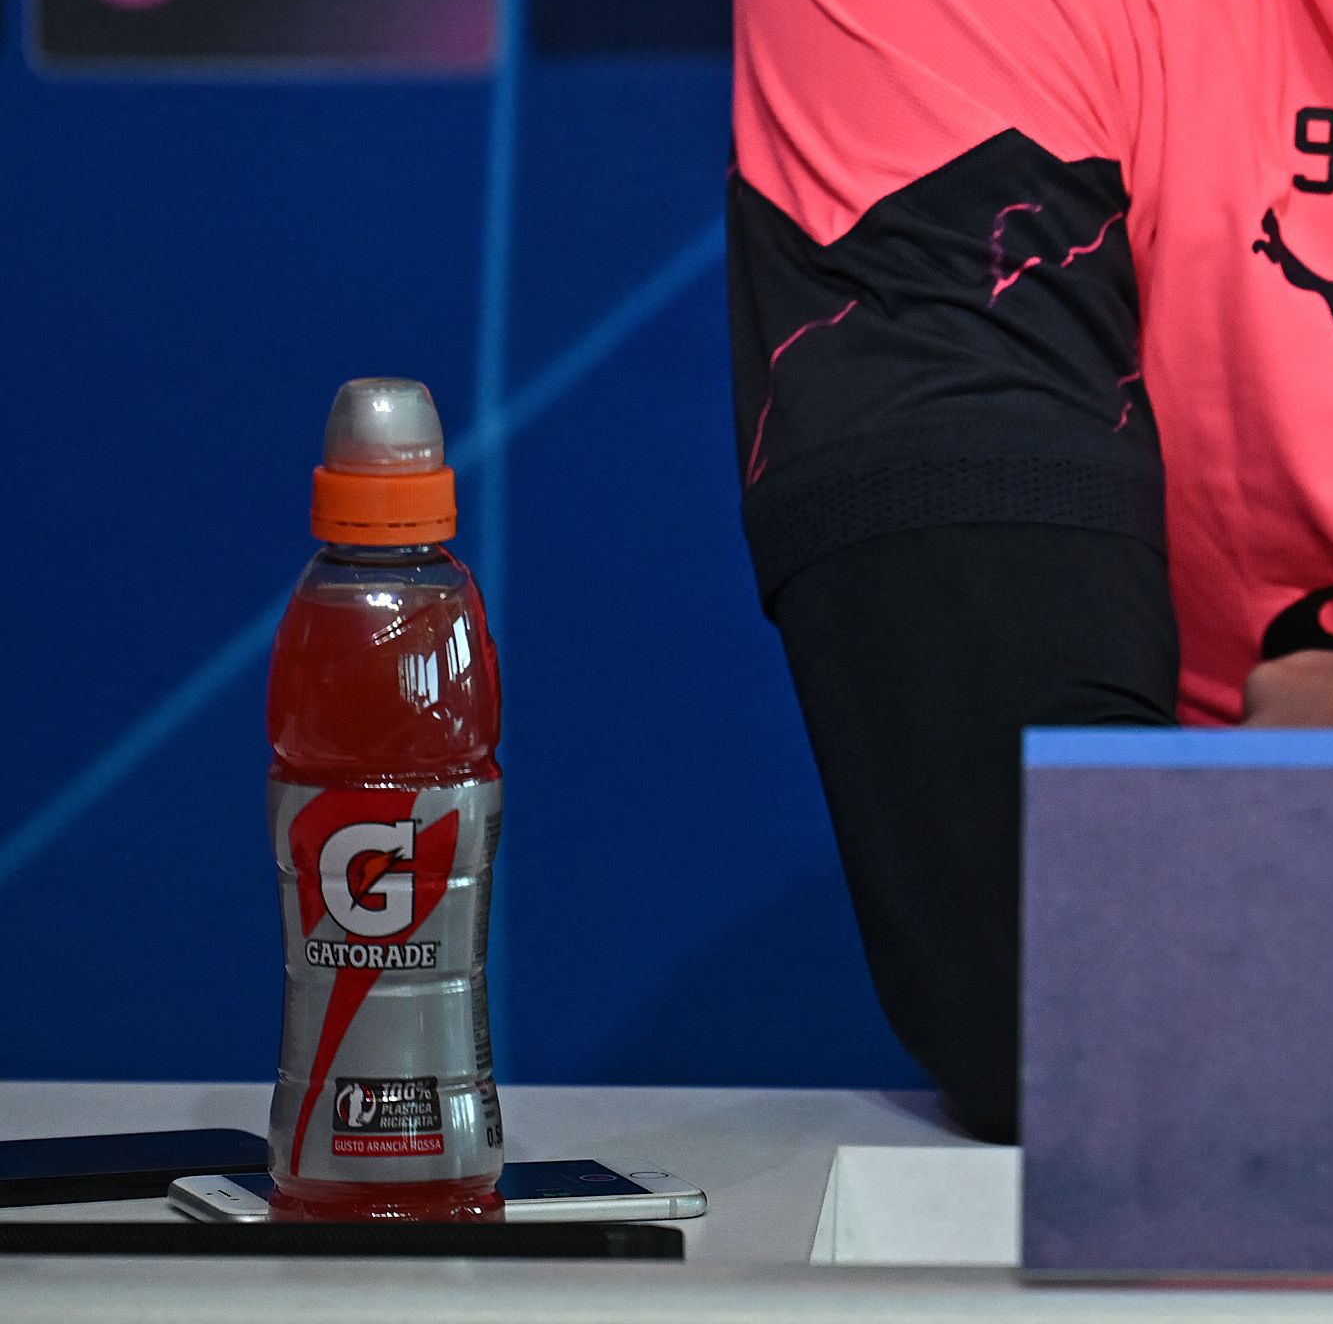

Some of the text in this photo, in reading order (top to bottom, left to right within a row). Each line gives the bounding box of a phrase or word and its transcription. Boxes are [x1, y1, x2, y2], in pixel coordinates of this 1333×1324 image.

[319, 821, 414, 937] G
[305, 940, 437, 968] GATORADE
[381, 1082, 432, 1102] 100%
[382, 1102, 433, 1116] PLASTICA
[334, 1139, 365, 1152] GUSTO
[366, 1140, 409, 1152] ARANCIA
